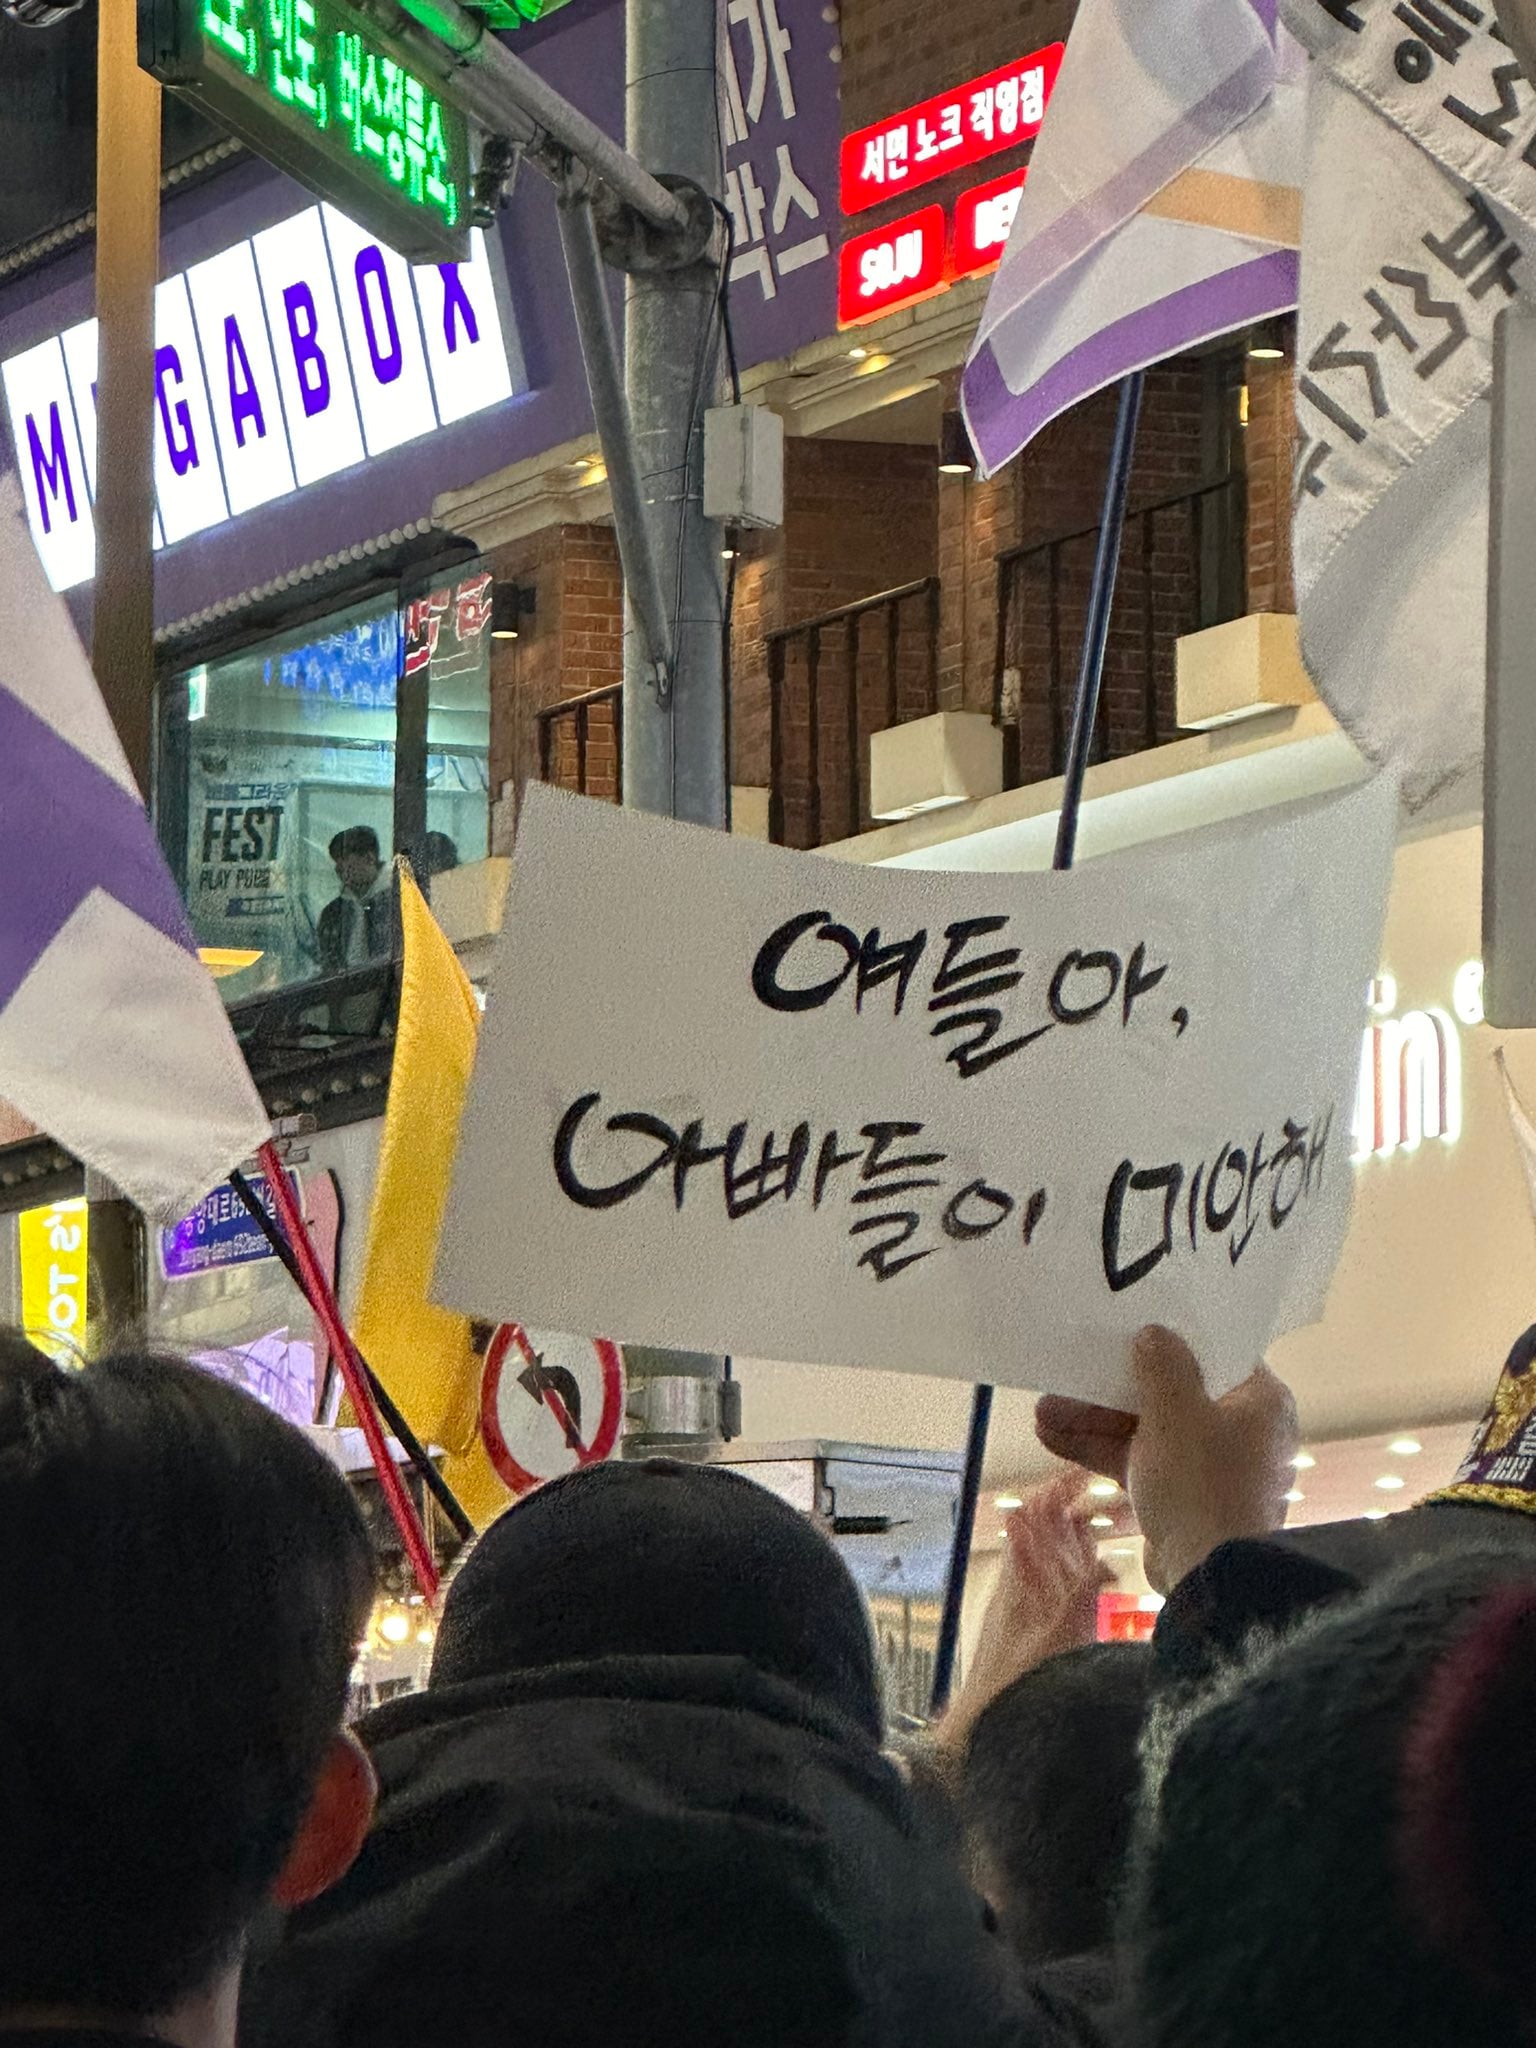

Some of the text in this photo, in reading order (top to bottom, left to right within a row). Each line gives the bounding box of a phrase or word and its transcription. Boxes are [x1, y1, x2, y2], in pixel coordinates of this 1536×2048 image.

[861, 65, 1045, 183] 서면 노크 직영점
[26, 244, 480, 533] MGABOX
[202, 806, 284, 863] FEST
[553, 1091, 1336, 1292] 아빠들이 미안해
